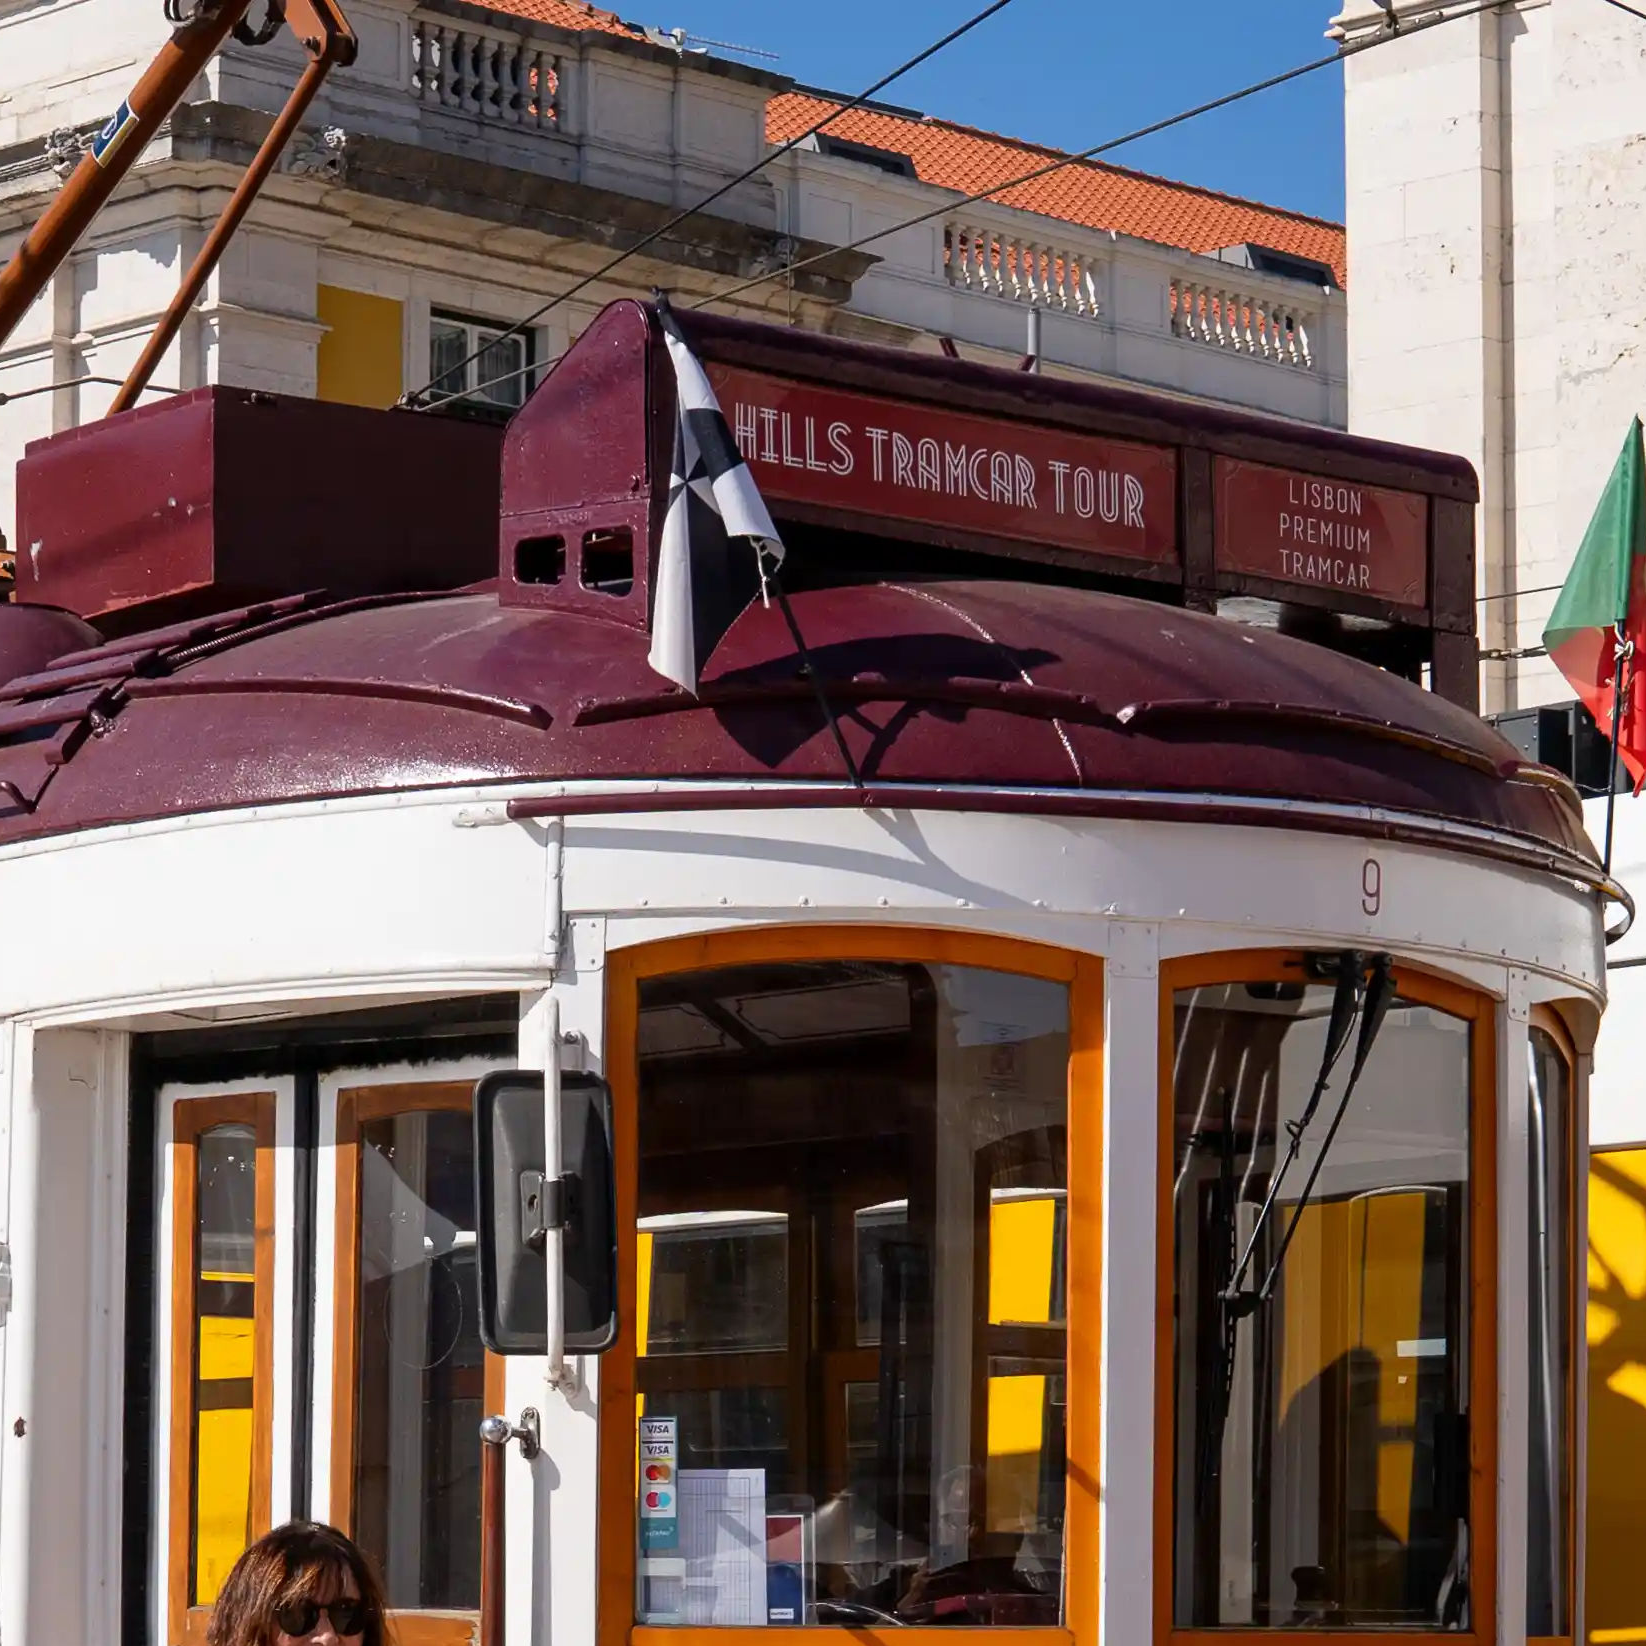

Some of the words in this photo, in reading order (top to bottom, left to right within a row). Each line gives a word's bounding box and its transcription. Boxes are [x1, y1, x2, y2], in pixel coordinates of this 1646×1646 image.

[735, 402, 854, 476] HILLS
[865, 426, 1038, 510] TRAMCAR
[1048, 459, 1145, 529] TOUR
[1289, 479, 1362, 517] LISBON
[1279, 512, 1370, 554] PREMIUM
[1279, 549, 1370, 589] TRAMCAR
[1362, 858, 1381, 916] 9
[646, 1425, 670, 1434] VISA
[646, 1445, 670, 1455] VISA
